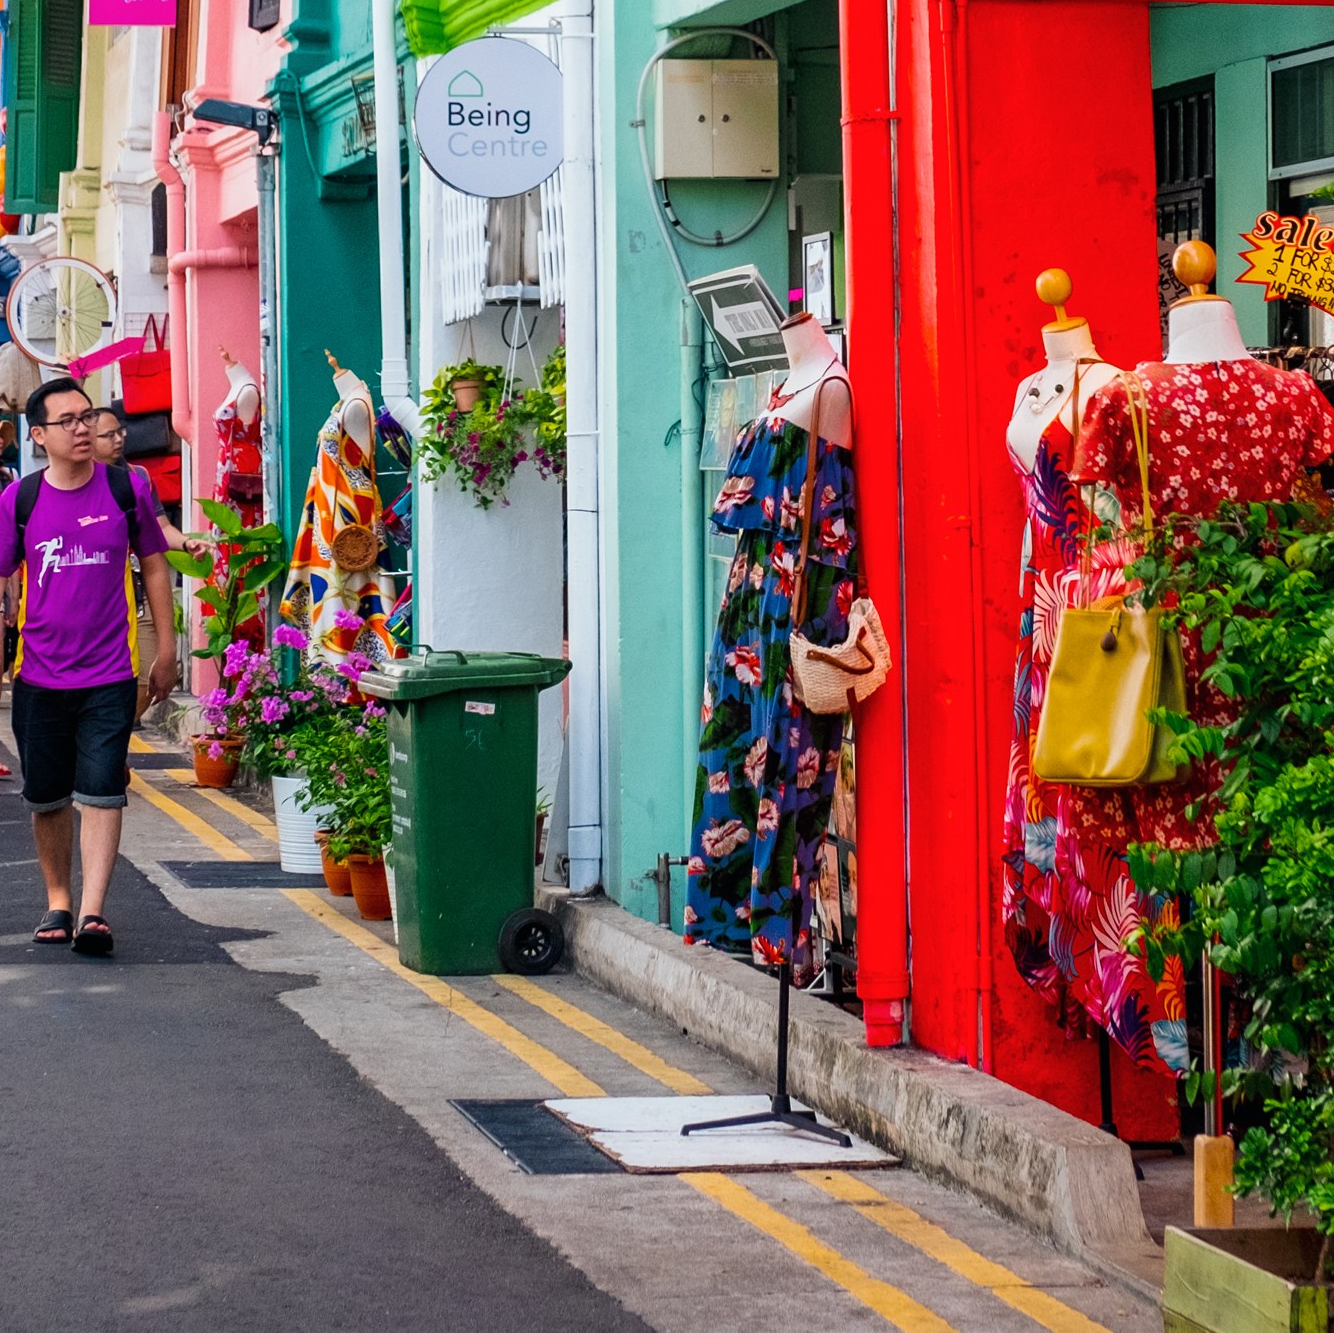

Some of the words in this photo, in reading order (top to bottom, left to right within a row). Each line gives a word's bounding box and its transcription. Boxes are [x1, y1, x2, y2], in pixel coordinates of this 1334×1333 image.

[448, 101, 531, 135] Being
[448, 132, 548, 157] Centre
[1272, 244, 1286, 264] 1
[1290, 248, 1320, 271] FOR
[1266, 262, 1279, 277] 2
[1286, 267, 1313, 289] FOR
